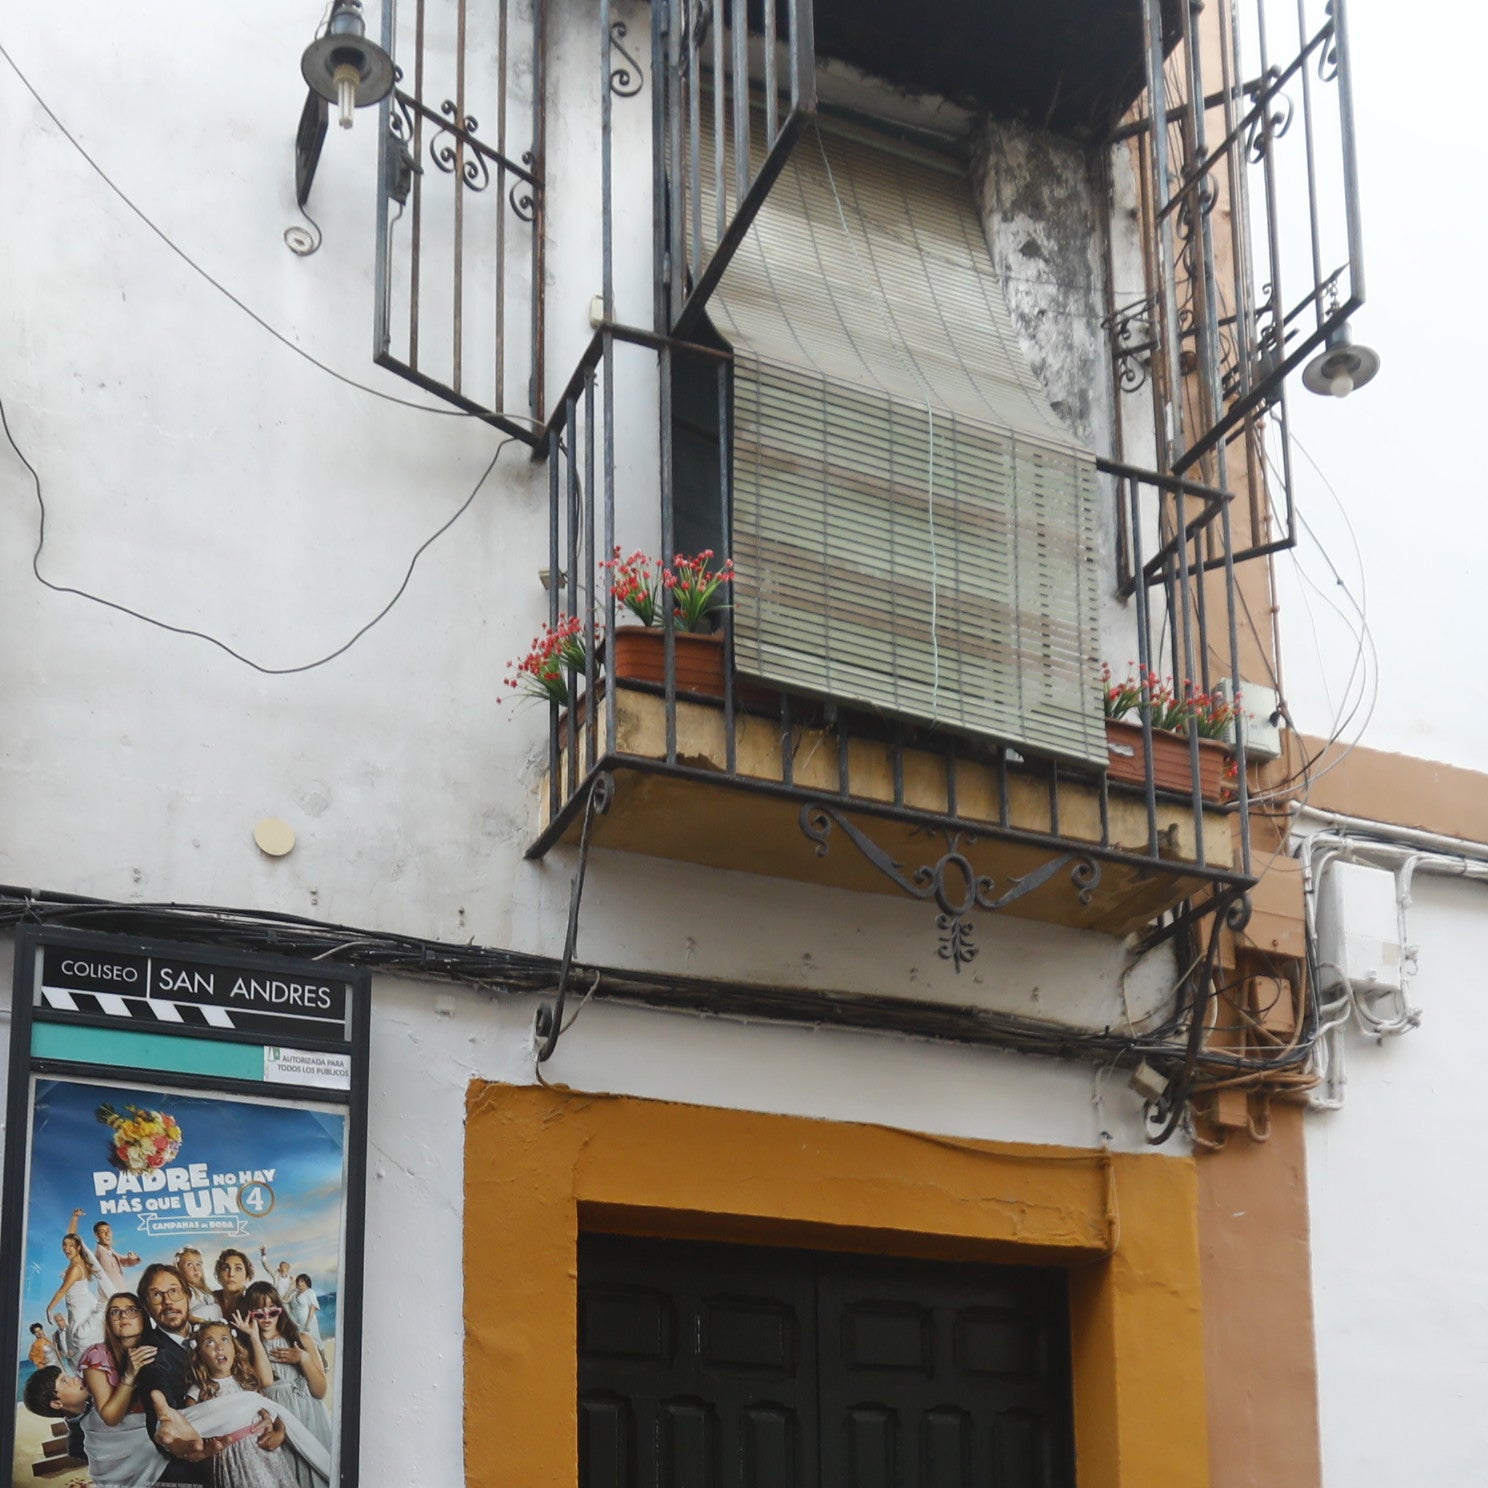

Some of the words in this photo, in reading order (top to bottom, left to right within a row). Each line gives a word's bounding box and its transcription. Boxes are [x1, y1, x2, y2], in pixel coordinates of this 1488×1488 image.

[61, 960, 138, 983] COLISEO
[159, 968, 214, 995] SAN
[230, 976, 331, 1009] ANDRES
[278, 1064, 301, 1073] TODOS
[303, 1066, 314, 1074] LOS
[316, 1067, 349, 1077] PUBLICOS
[282, 1055, 325, 1067] AUTORIZADA
[327, 1060, 345, 1068] PARA
[92, 1163, 210, 1196] PADRE
[213, 1173, 237, 1186] NO
[238, 1168, 277, 1185] HAY
[99, 1196, 143, 1215] MÁS
[145, 1197, 181, 1211] QUE
[246, 1187, 264, 1211] 4
[152, 1222, 200, 1231] CAMPANAS
